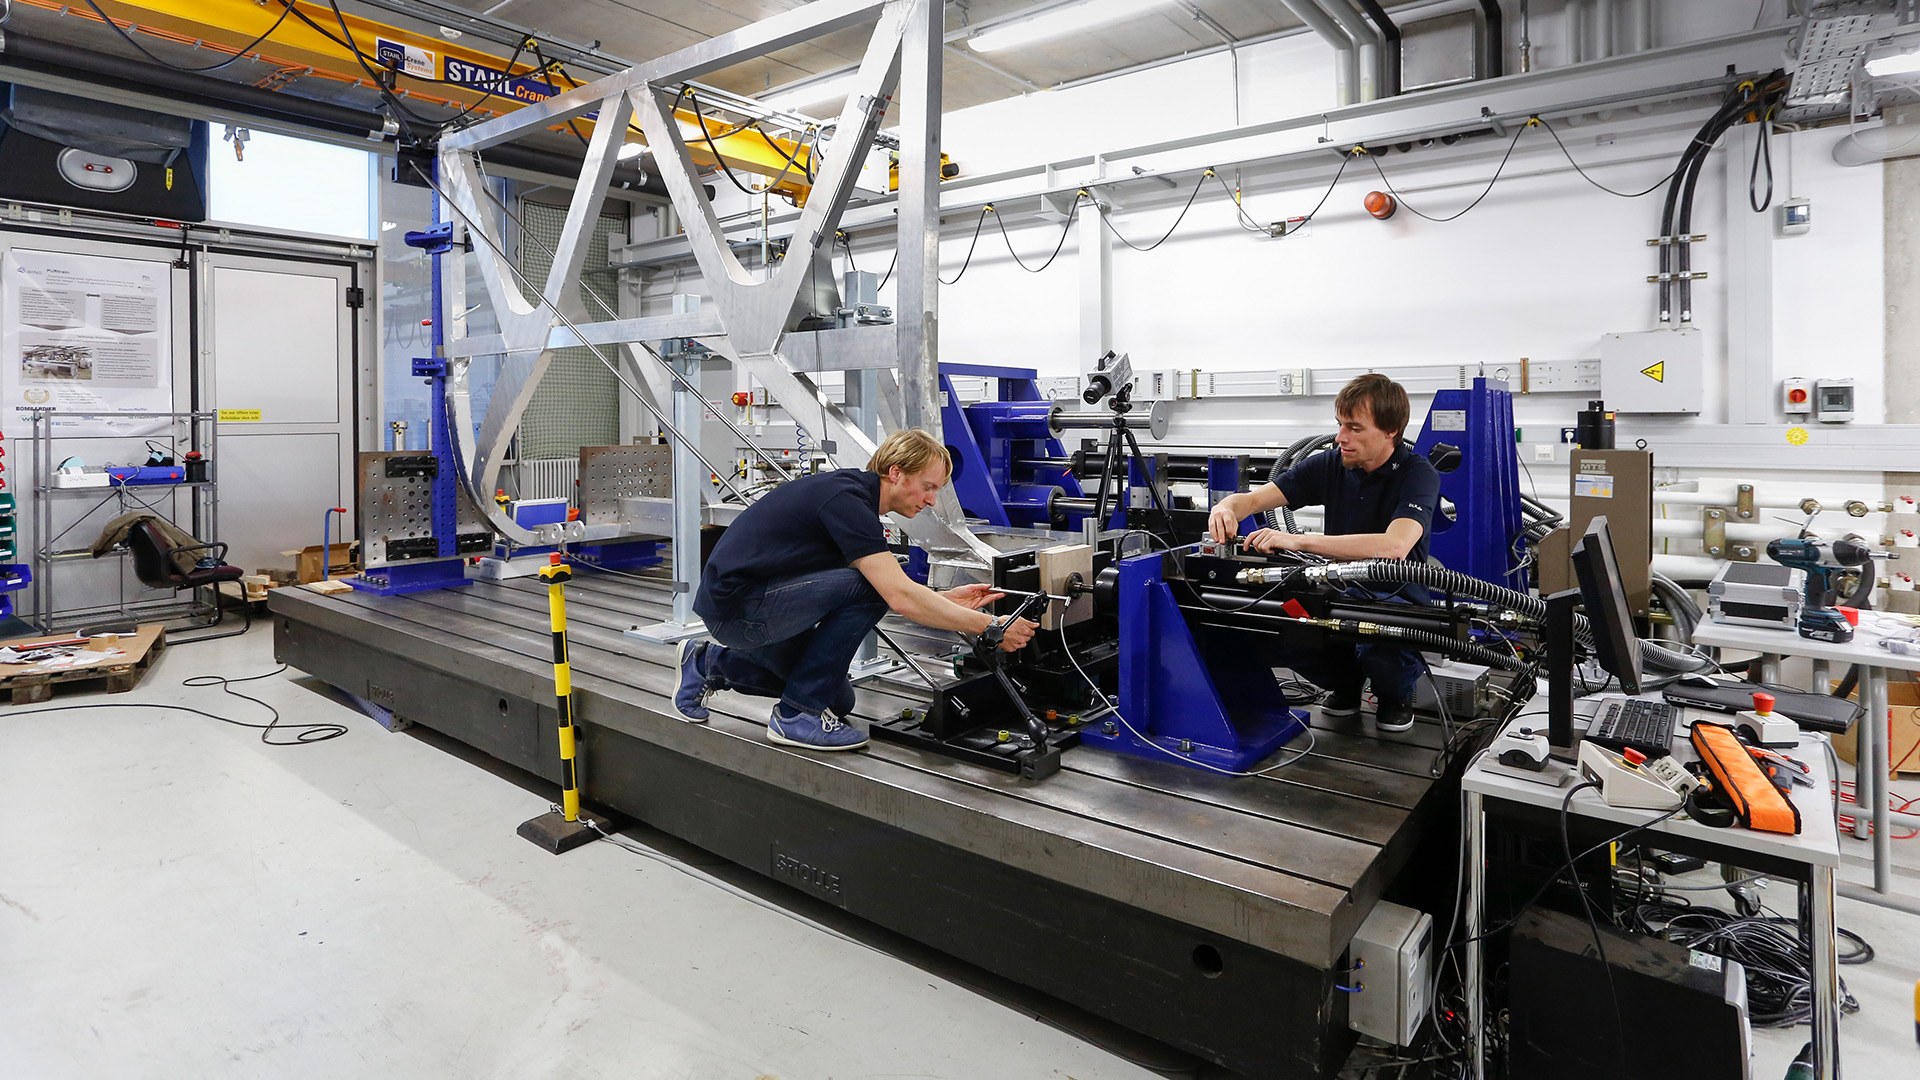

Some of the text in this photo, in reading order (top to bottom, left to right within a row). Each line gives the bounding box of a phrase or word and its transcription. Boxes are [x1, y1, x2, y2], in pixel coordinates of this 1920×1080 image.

[382, 50, 426, 66] STAHL Crane
[406, 63, 433, 74] Systems
[448, 61, 515, 96] STAHL
[777, 853, 840, 894] STOLLE
